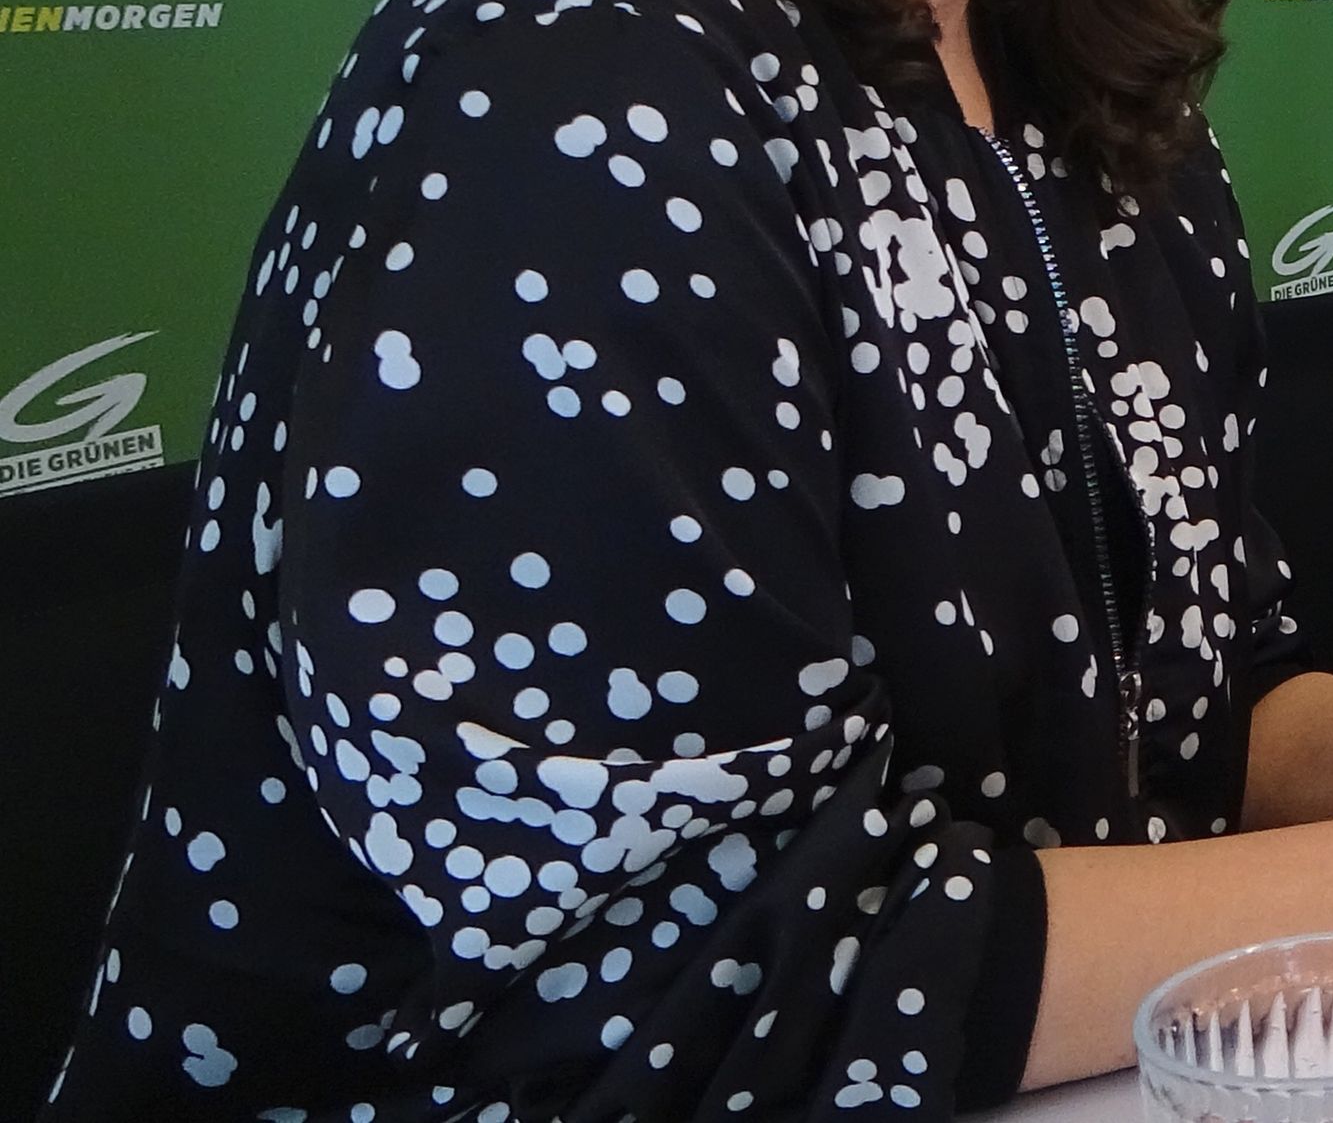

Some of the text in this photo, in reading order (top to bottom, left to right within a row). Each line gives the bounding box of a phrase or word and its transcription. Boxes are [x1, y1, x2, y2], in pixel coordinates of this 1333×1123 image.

[0, 3, 223, 32] IENMORGEN
[0, 458, 42, 483] DIE
[48, 433, 155, 472] GRÜNEN
